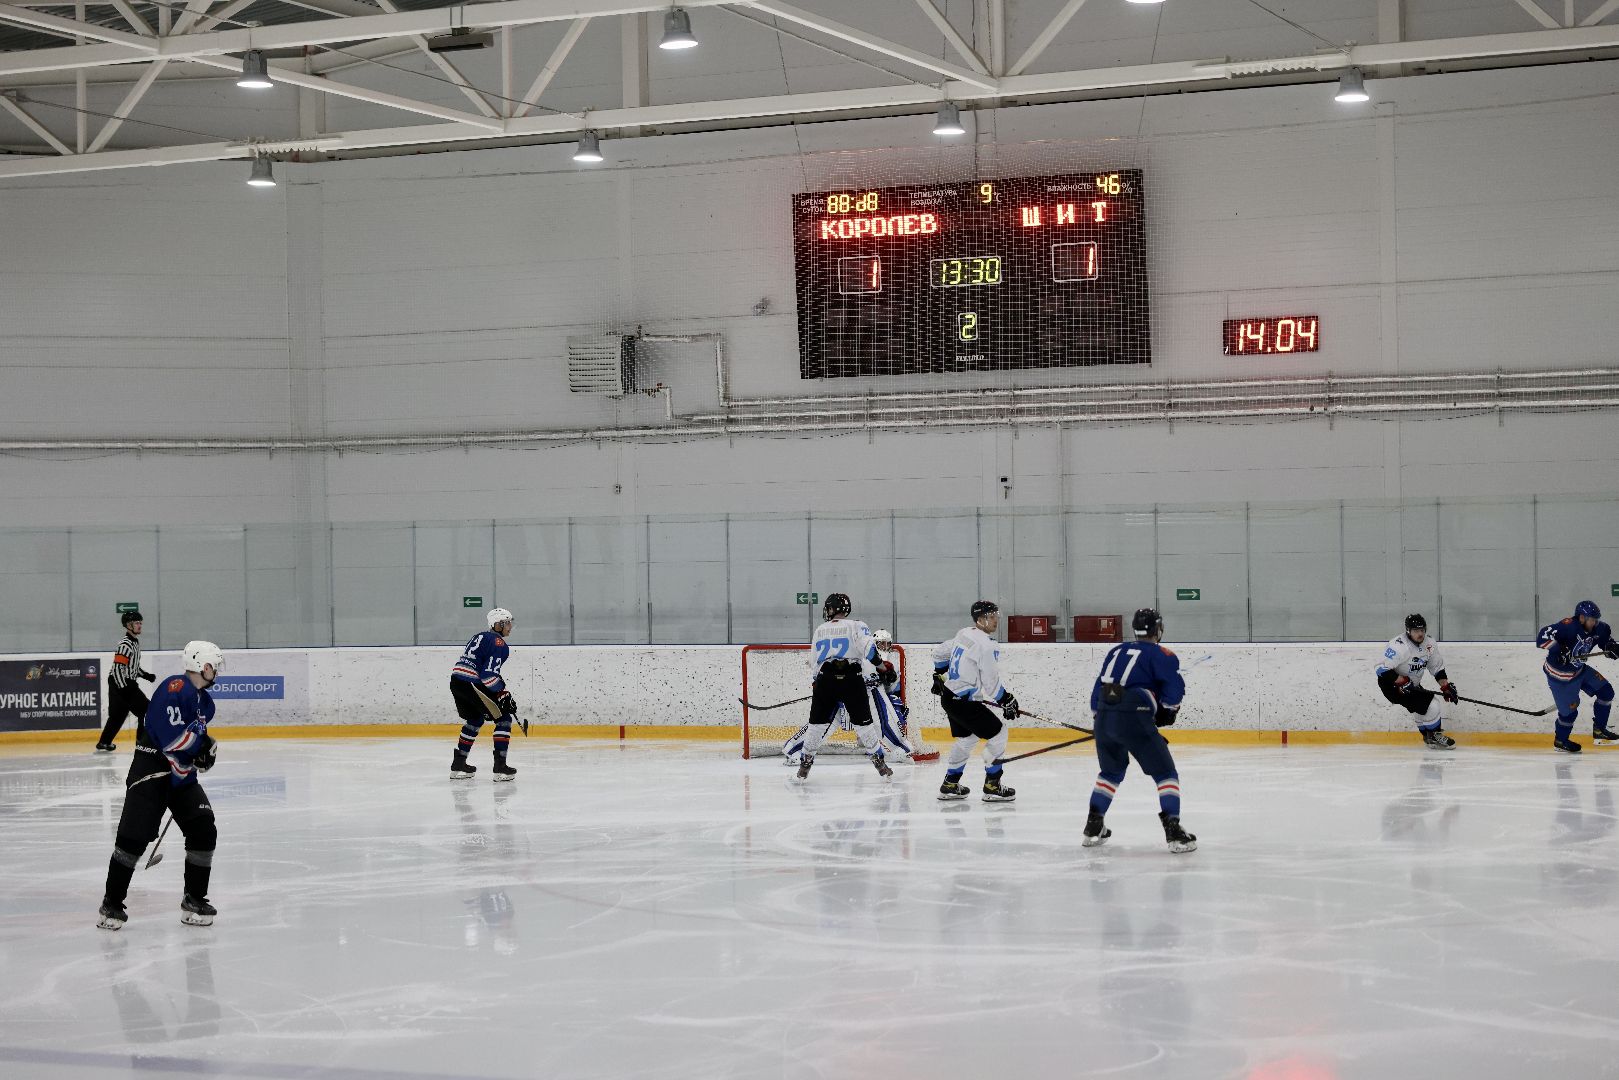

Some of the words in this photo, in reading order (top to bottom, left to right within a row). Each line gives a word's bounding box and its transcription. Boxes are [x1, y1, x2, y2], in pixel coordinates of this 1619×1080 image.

[980, 183, 992, 204] 9
[1096, 174, 1120, 195] 46
[821, 213, 938, 240] КОРОЛЕВ
[871, 261, 878, 288] 1
[942, 258, 999, 285] 13:30
[1087, 246, 1094, 276] 1
[962, 314, 976, 339] 2
[1238, 319, 1316, 353] 14.04
[484, 655, 502, 674] 12
[1101, 647, 1142, 687] 17
[41, 690, 97, 708] КАТАНИЕ
